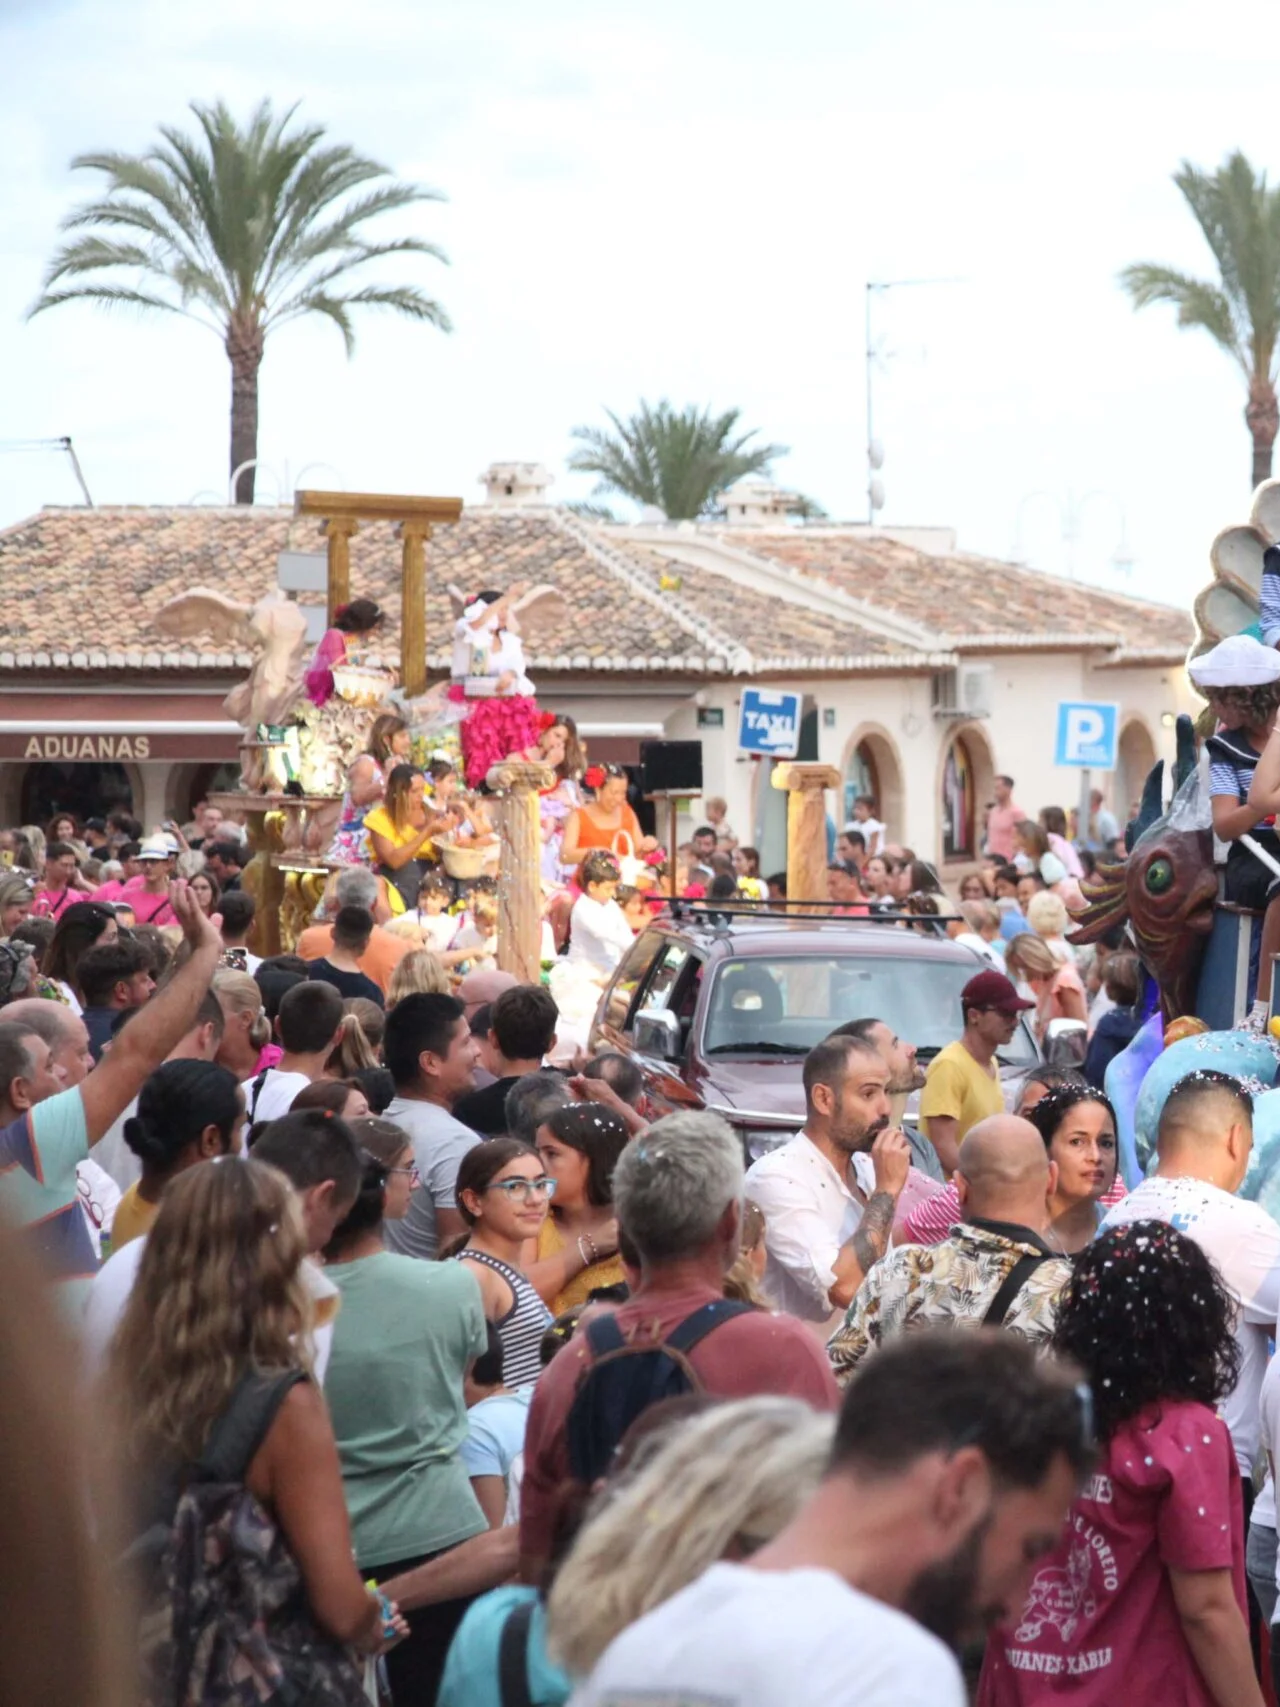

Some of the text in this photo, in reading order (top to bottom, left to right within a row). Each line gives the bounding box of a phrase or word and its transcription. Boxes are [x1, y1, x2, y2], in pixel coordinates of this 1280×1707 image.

[745, 710, 795, 731] TAXI
[1065, 708, 1105, 760] P
[24, 735, 150, 759] ADUANAS
[1084, 1525, 1119, 1591] LORETO
